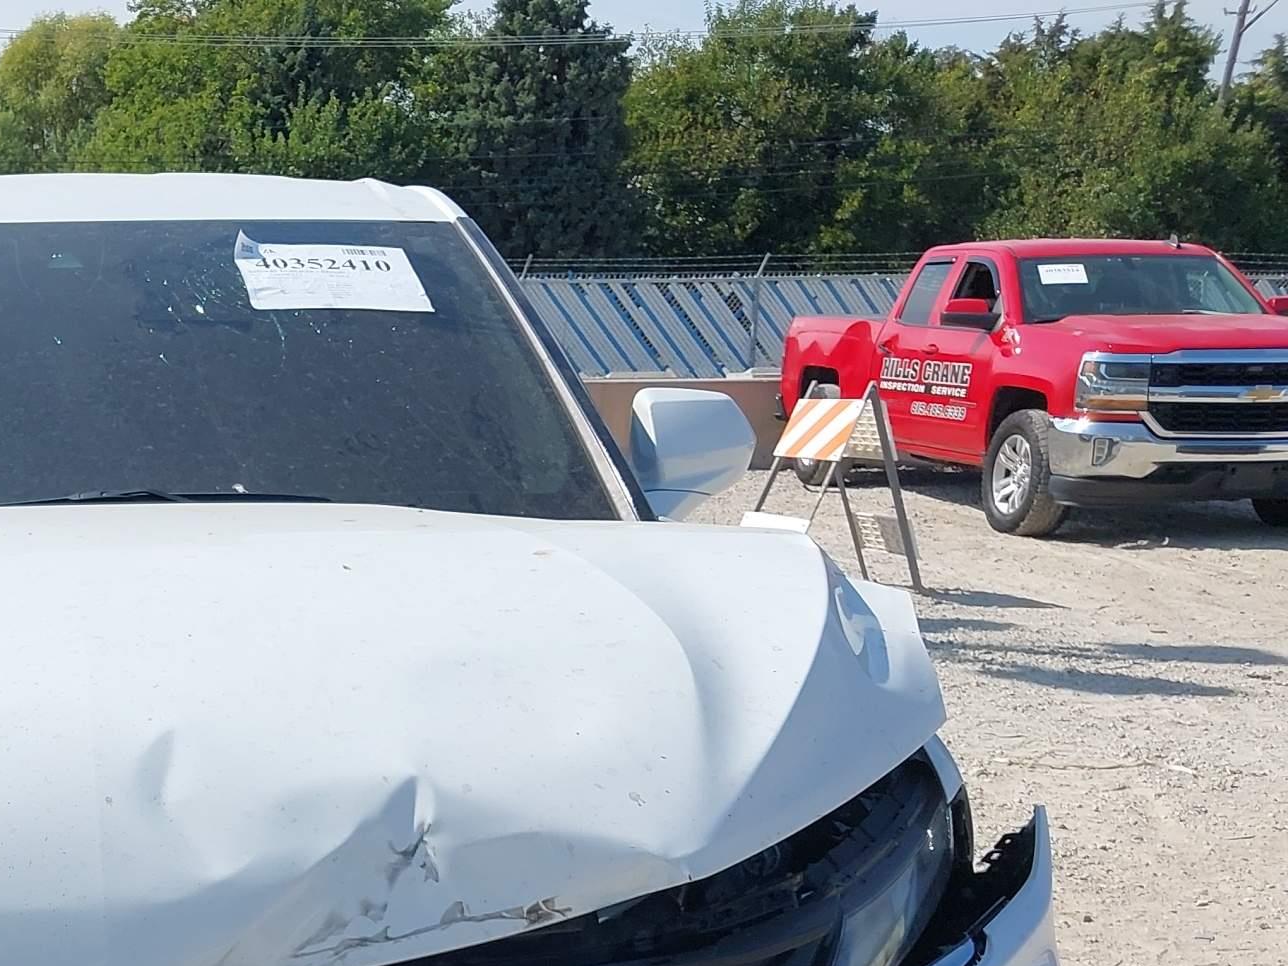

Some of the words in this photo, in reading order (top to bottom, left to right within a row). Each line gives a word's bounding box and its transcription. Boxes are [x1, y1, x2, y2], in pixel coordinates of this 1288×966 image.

[255, 257, 392, 273] 40352410
[880, 357, 920, 381] HILLS
[922, 359, 972, 386] CRANE
[879, 381, 925, 394] INSPECTION
[931, 385, 967, 398] SERVICE
